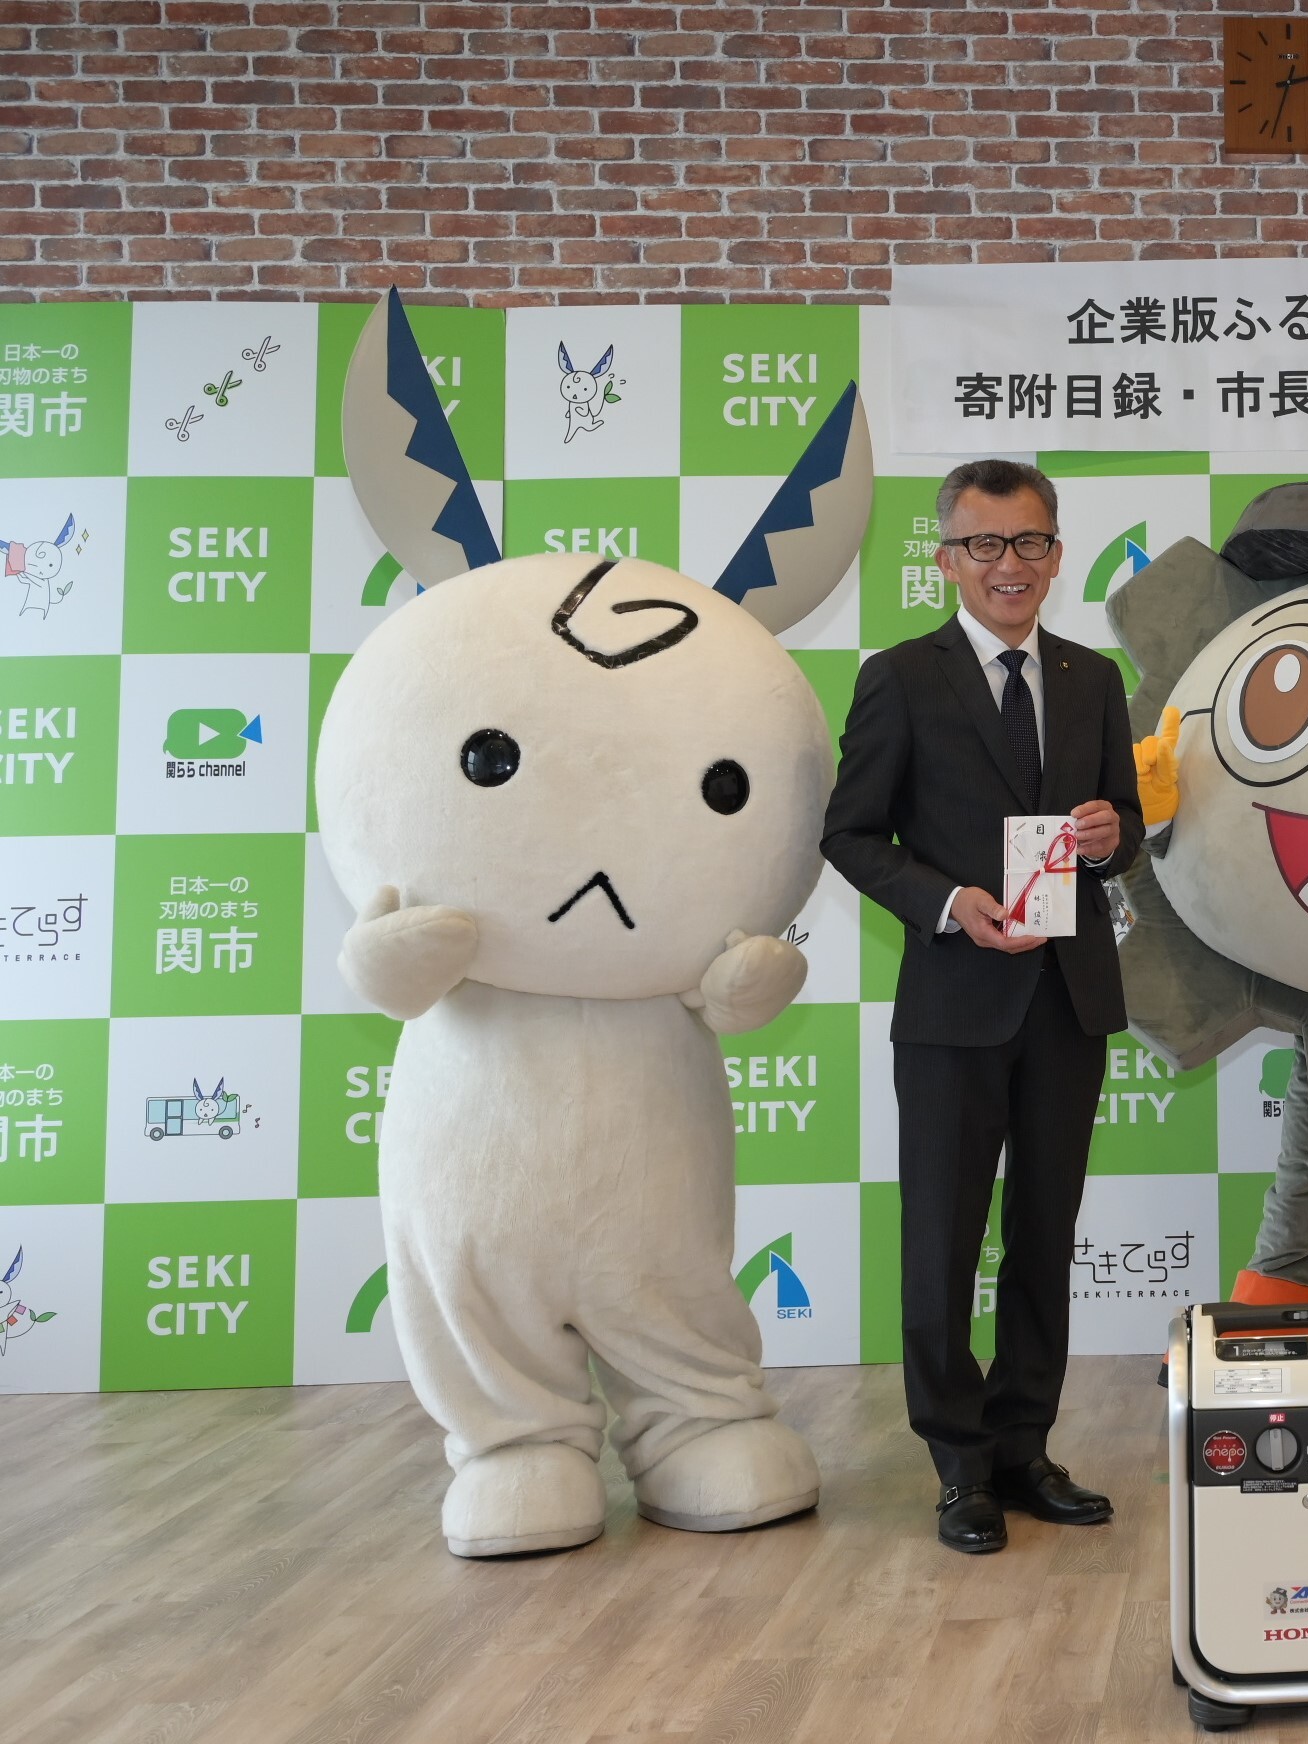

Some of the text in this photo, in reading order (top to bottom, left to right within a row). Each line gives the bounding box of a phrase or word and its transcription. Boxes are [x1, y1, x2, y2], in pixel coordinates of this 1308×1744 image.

[5, 343, 79, 362] 日本一の
[722, 352, 818, 384] SEKI
[0, 366, 88, 386] 刃物のまち
[421, 355, 461, 387] KI
[0, 391, 88, 438] 関市
[722, 395, 817, 427] CITY
[167, 526, 269, 558] SEKI
[543, 531, 638, 558] SEKI
[167, 570, 267, 603] CITY
[901, 565, 961, 610] 関
[0, 707, 76, 740] EKI
[0, 752, 75, 785] ITY
[165, 760, 246, 779] 関らら channel
[169, 875, 249, 895] 日本一の
[158, 898, 258, 920] 刃物のまち
[4, 953, 81, 962] TERRACE
[155, 925, 258, 975] 関市
[345, 1065, 394, 1098] SE
[723, 1055, 817, 1089] SEKI
[0, 1087, 64, 1108] のまち
[0, 1113, 63, 1163] 市
[345, 1111, 384, 1144] CI
[147, 1253, 250, 1289] SEKI
[1073, 1230, 1195, 1284] せきてらす
[1072, 1289, 1190, 1299] SEKITERRACE
[146, 1300, 249, 1336] CITY
[776, 1308, 812, 1320] SEKI
[1269, 1413, 1285, 1422] 停止
[1205, 1447, 1245, 1463] enepo
